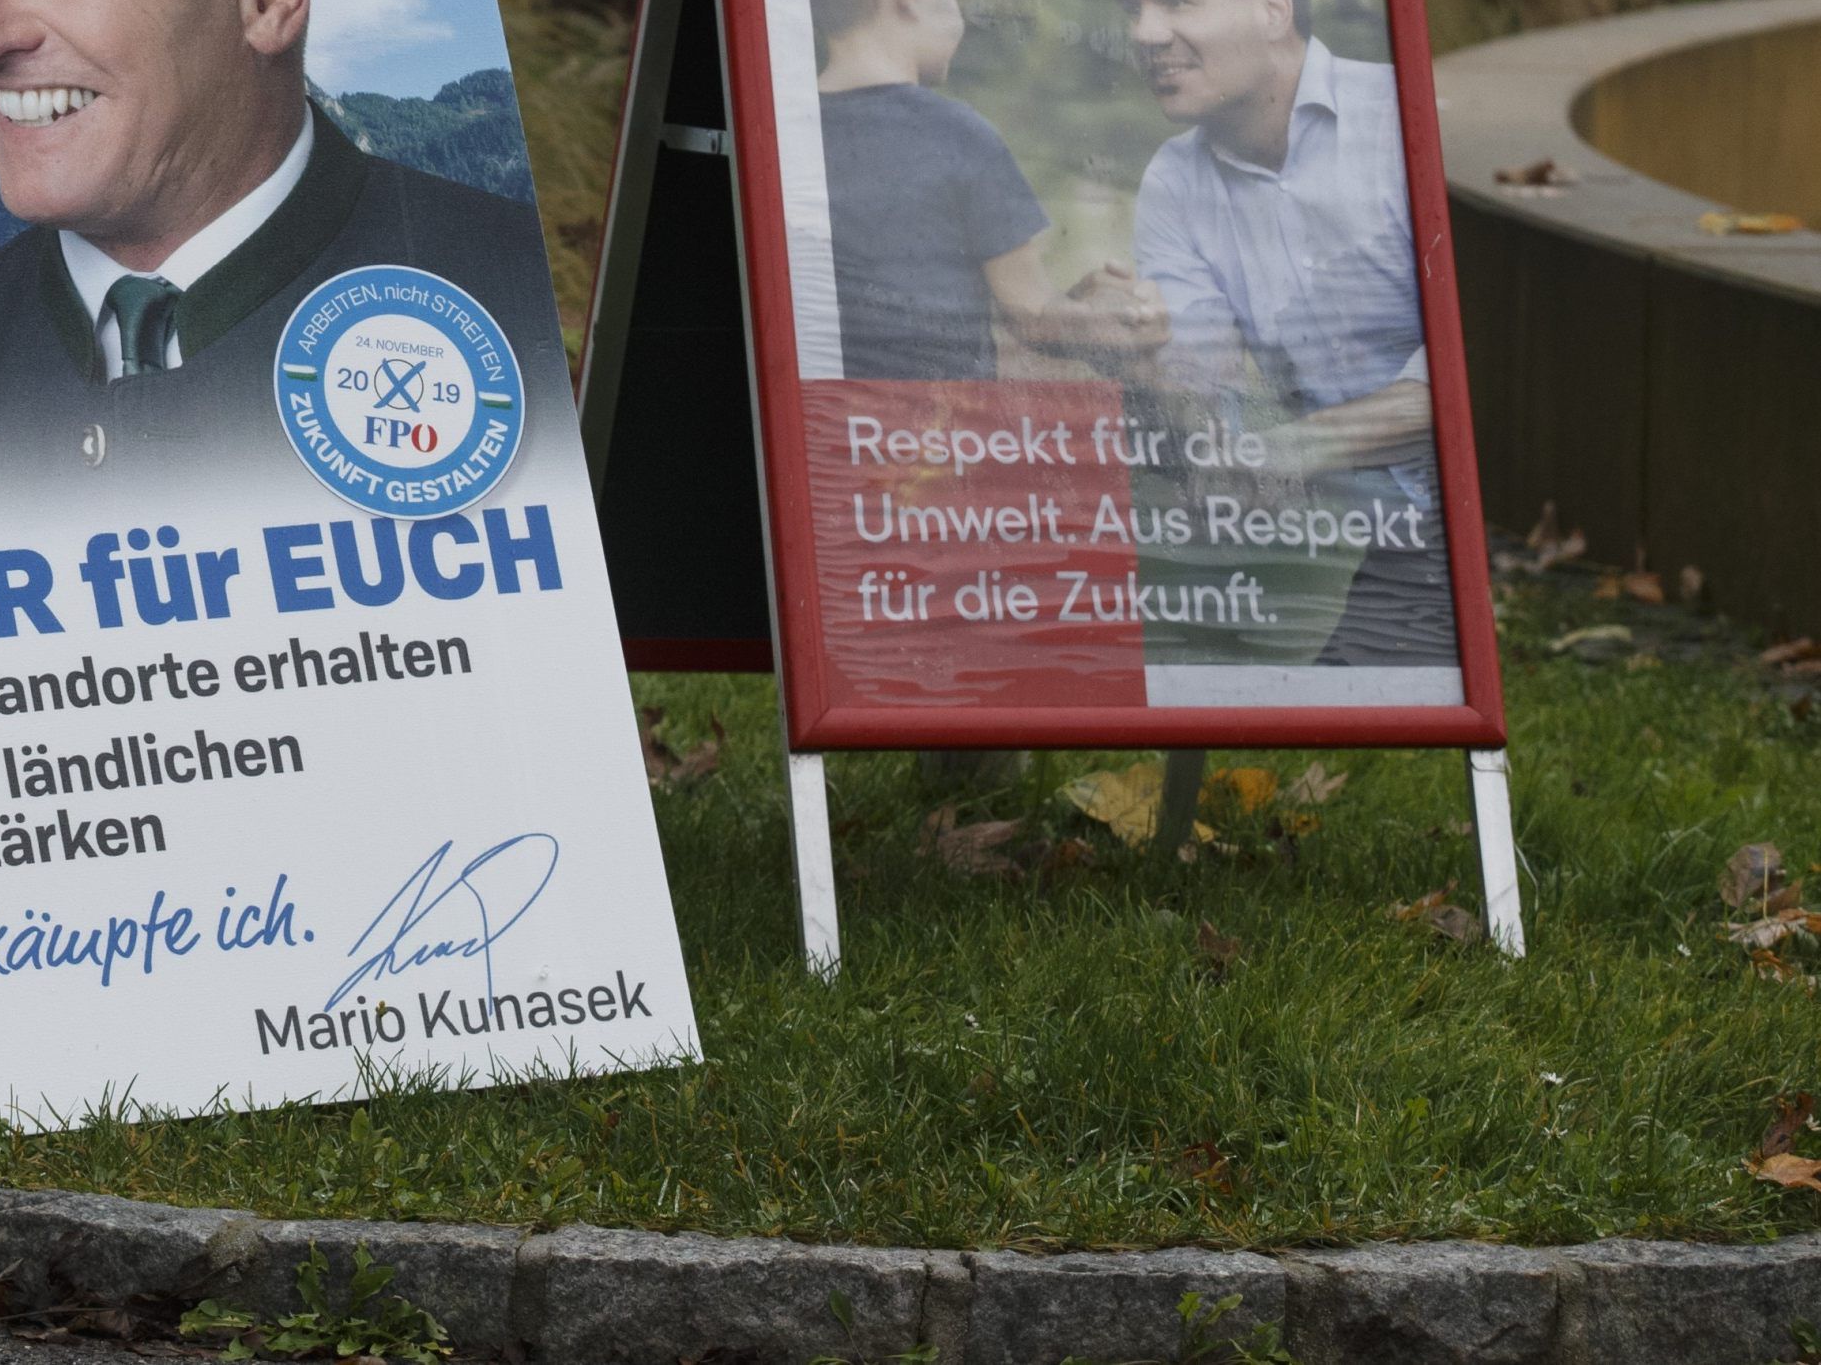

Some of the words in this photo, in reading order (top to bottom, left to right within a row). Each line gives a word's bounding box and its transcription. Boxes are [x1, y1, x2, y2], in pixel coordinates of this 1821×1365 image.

[297, 283, 383, 355] ARBEITEN,
[383, 283, 431, 306] nicht
[430, 294, 505, 383] STREITEN
[355, 336, 374, 350] 24.
[375, 339, 445, 359] NOVEMBER
[337, 368, 370, 392] 20
[432, 382, 461, 404] 19
[290, 391, 384, 495] ZUKUNFT
[385, 419, 509, 503] GESTALTEN
[847, 416, 1076, 474] Respekt
[1090, 417, 1161, 467] für
[1184, 420, 1266, 468] die
[853, 494, 1078, 543] Umwelt.
[1089, 495, 1192, 545] Aus
[1206, 496, 1425, 556] Respekt
[79, 526, 242, 630] für
[262, 504, 563, 615] EUCH
[857, 572, 936, 621] für
[954, 572, 1039, 621] die
[1056, 572, 1279, 623] Zukunft.
[233, 631, 473, 695] erhalten
[1, 728, 304, 800] ländlichen
[217, 873, 316, 953] ich.
[253, 995, 406, 1058] Mario
[418, 970, 653, 1039] Kunasek
